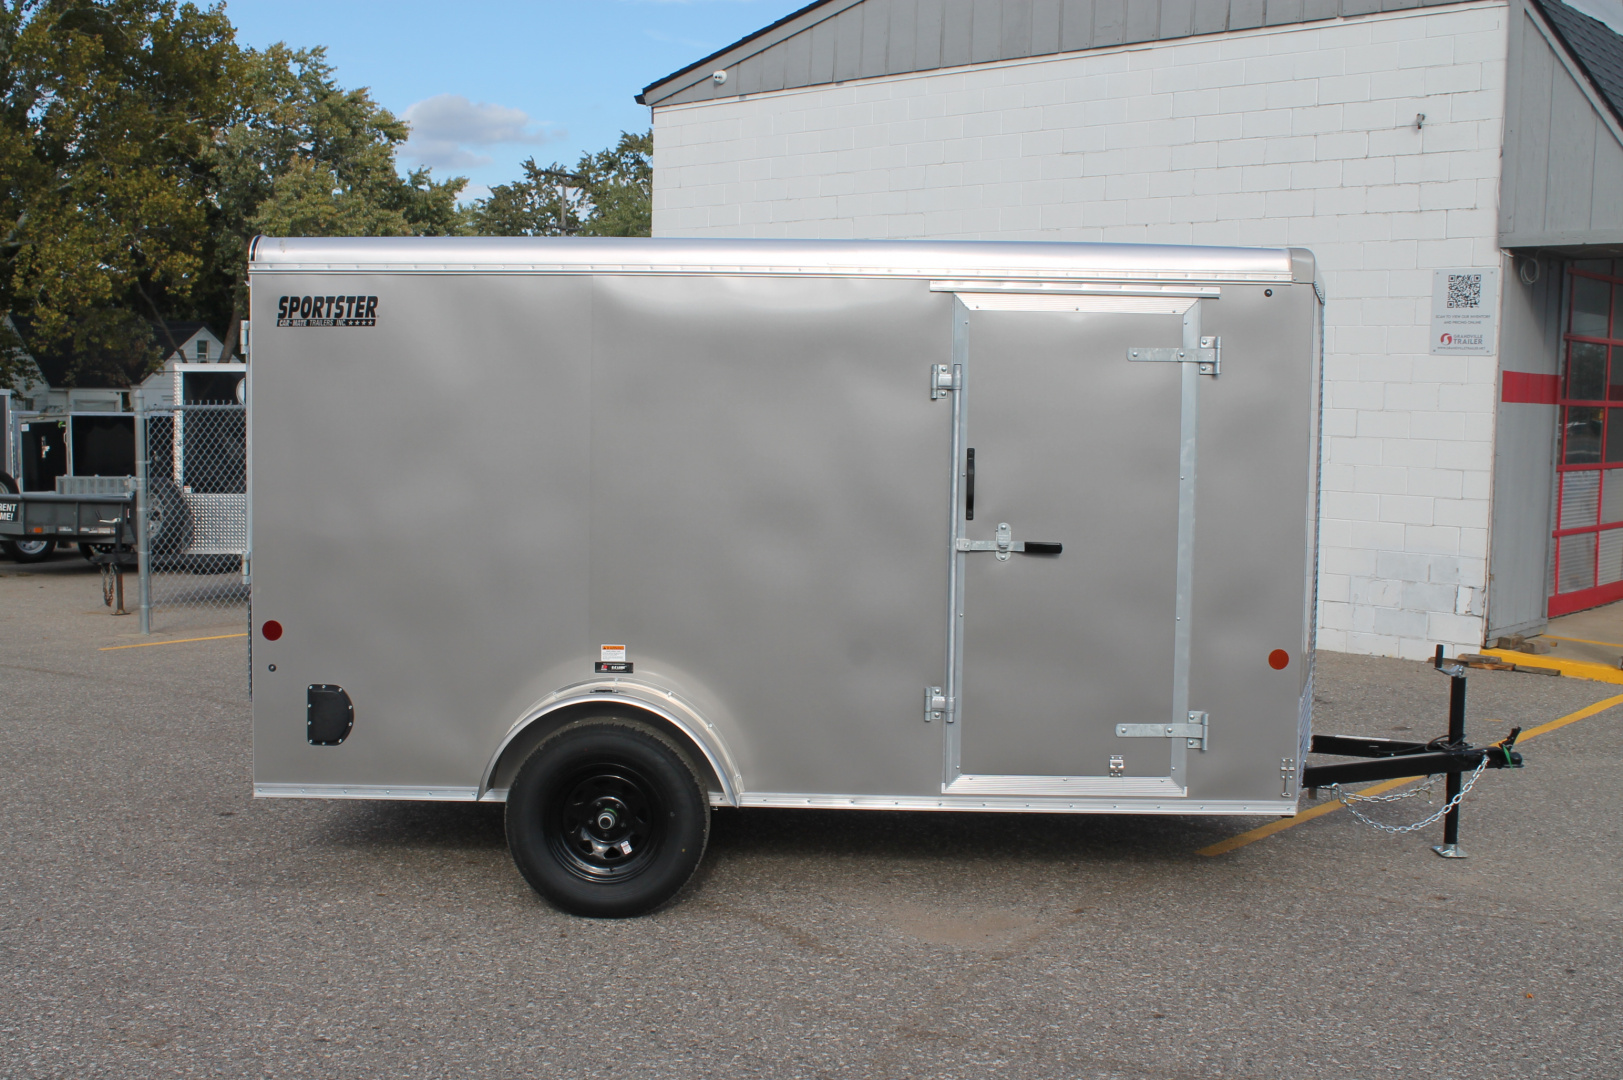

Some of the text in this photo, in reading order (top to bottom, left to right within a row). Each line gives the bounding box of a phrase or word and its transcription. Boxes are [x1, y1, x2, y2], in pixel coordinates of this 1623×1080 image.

[277, 296, 378, 319] SPORTSTER
[0, 503, 17, 512] RENT
[0, 512, 14, 521] ME!
